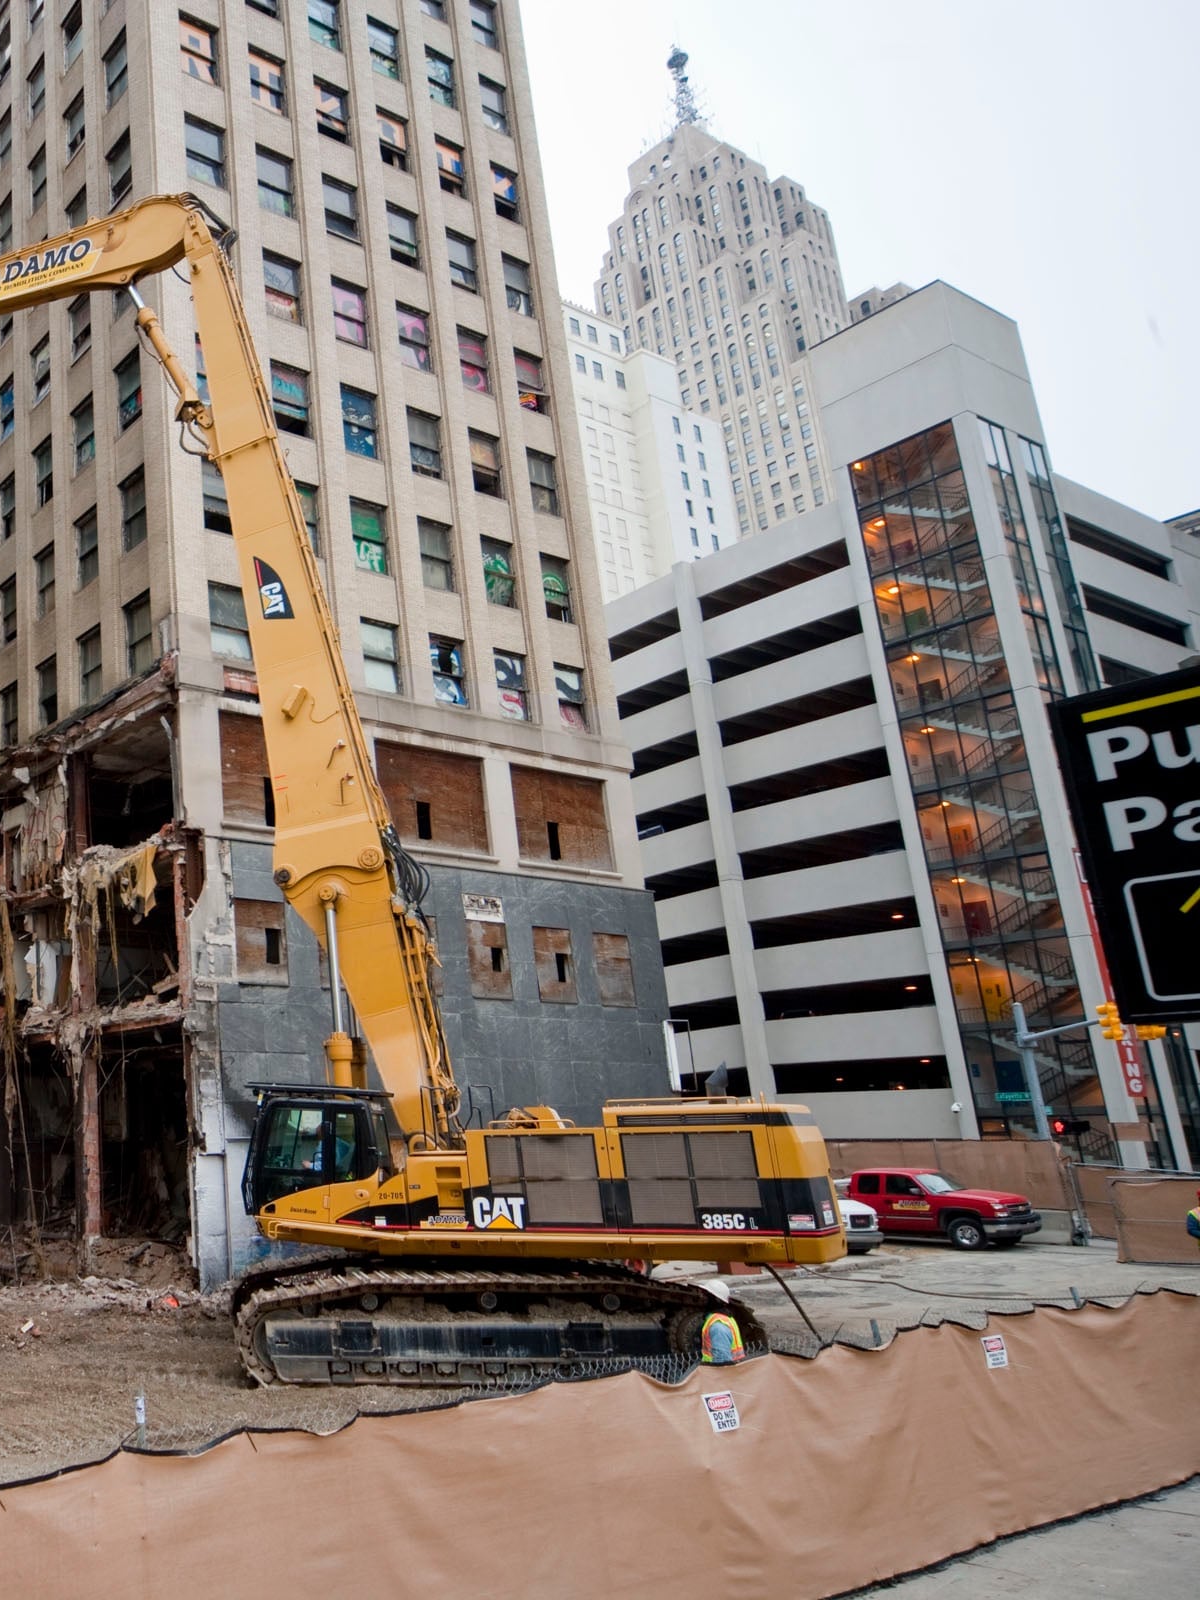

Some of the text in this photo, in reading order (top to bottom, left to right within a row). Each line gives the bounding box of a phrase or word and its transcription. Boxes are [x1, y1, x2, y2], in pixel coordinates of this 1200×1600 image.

[3, 262, 84, 291] DEMOLITION COMPANY
[261, 582, 285, 615] CAT
[1086, 725, 1200, 782] Pu
[428, 1215, 466, 1225] ADAMO
[472, 1197, 525, 1229] CAT
[701, 1213, 759, 1230] 385C L
[712, 1409, 736, 1421] DO NOT
[717, 1419, 737, 1430] ENTER
